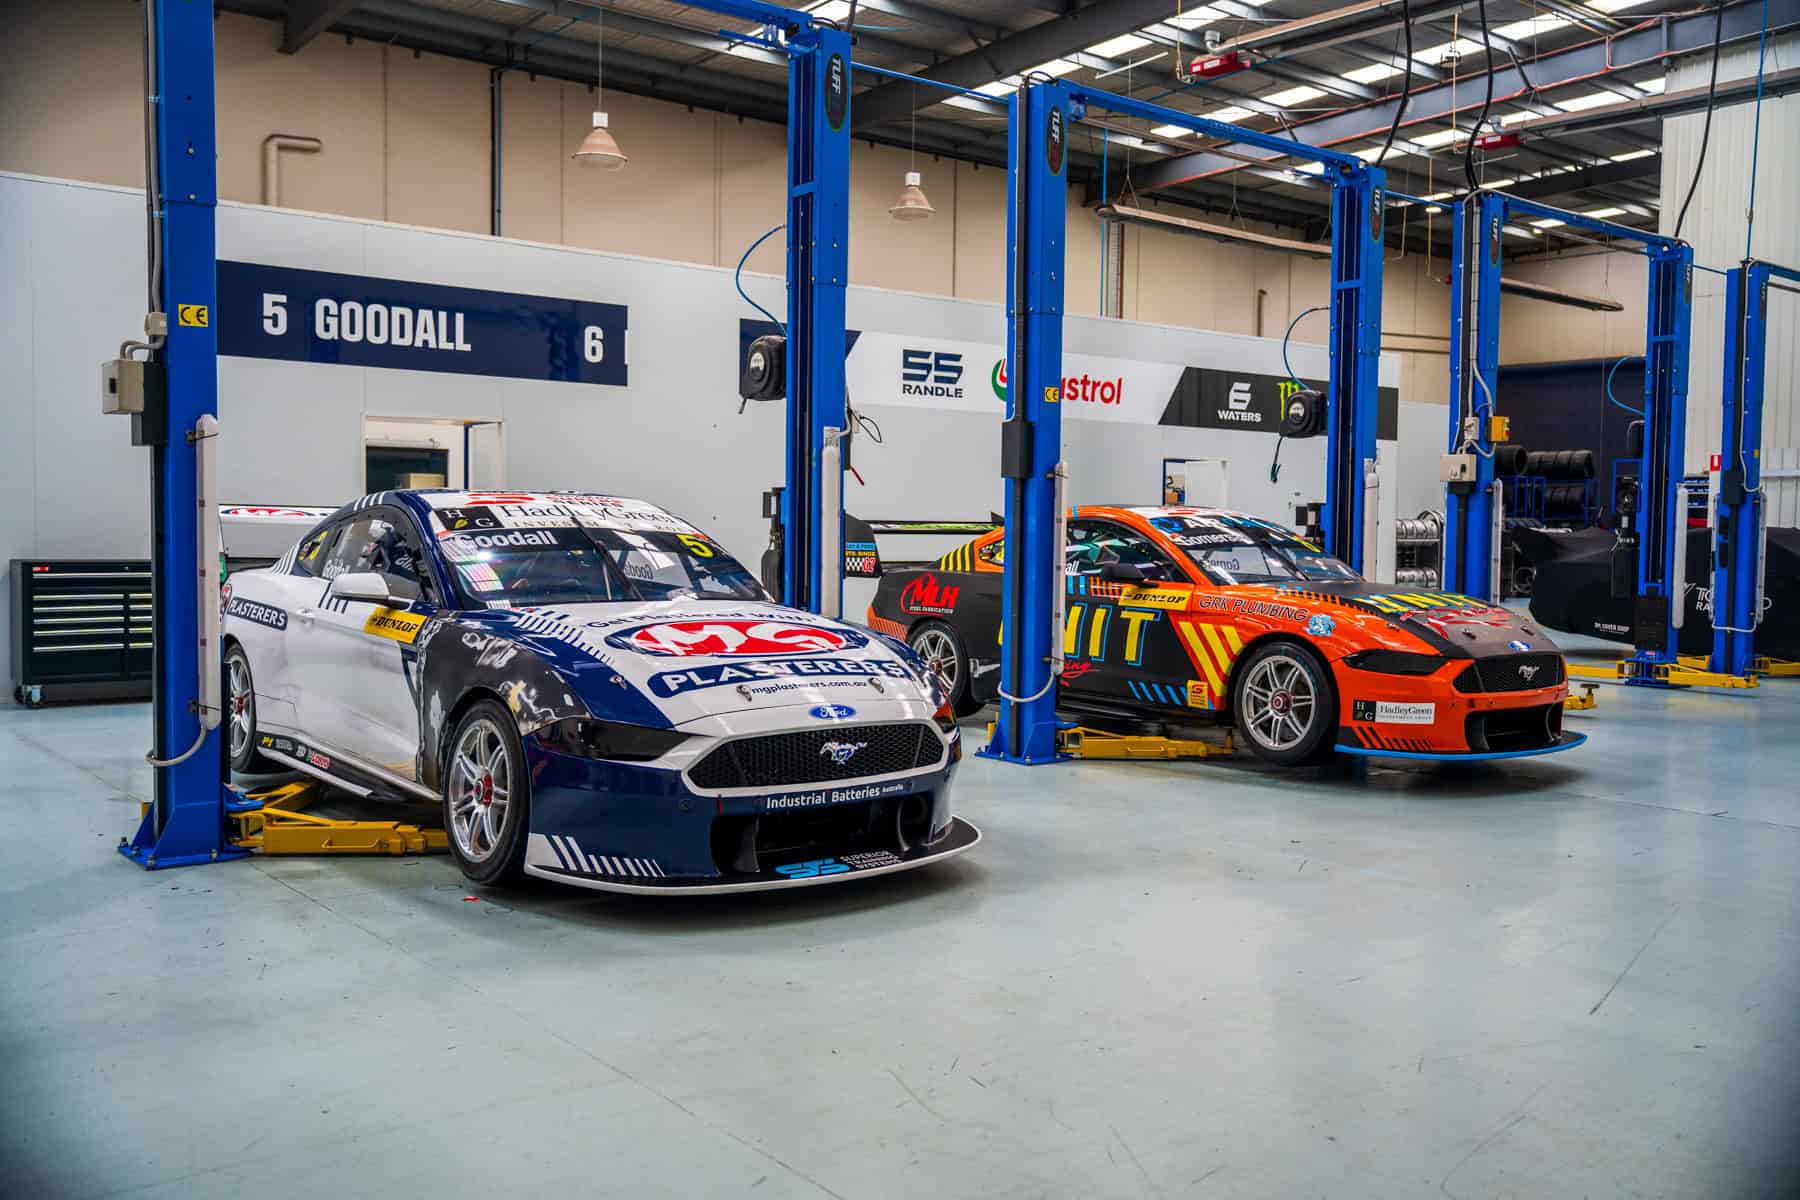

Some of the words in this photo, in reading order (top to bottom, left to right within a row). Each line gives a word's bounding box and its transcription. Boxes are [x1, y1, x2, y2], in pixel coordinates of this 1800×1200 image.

[832, 58, 841, 94] TUFF
[263, 293, 288, 336] 5
[315, 298, 472, 352] GOODALL
[584, 326, 604, 363] 6
[902, 383, 963, 398] RANDLE
[1217, 409, 1262, 422] WATERS
[443, 510, 465, 518] H
[458, 528, 559, 549] Goodall
[676, 532, 715, 558] 5
[1133, 593, 1186, 604] DUNLOP
[1233, 599, 1308, 621] PLUMBING
[375, 615, 418, 632] DUNLOP
[663, 661, 905, 692] PLASTERERS
[1356, 701, 1366, 711] H
[1364, 711, 1374, 721] G
[766, 791, 826, 809] Industrial
[831, 786, 881, 803] Batteries
